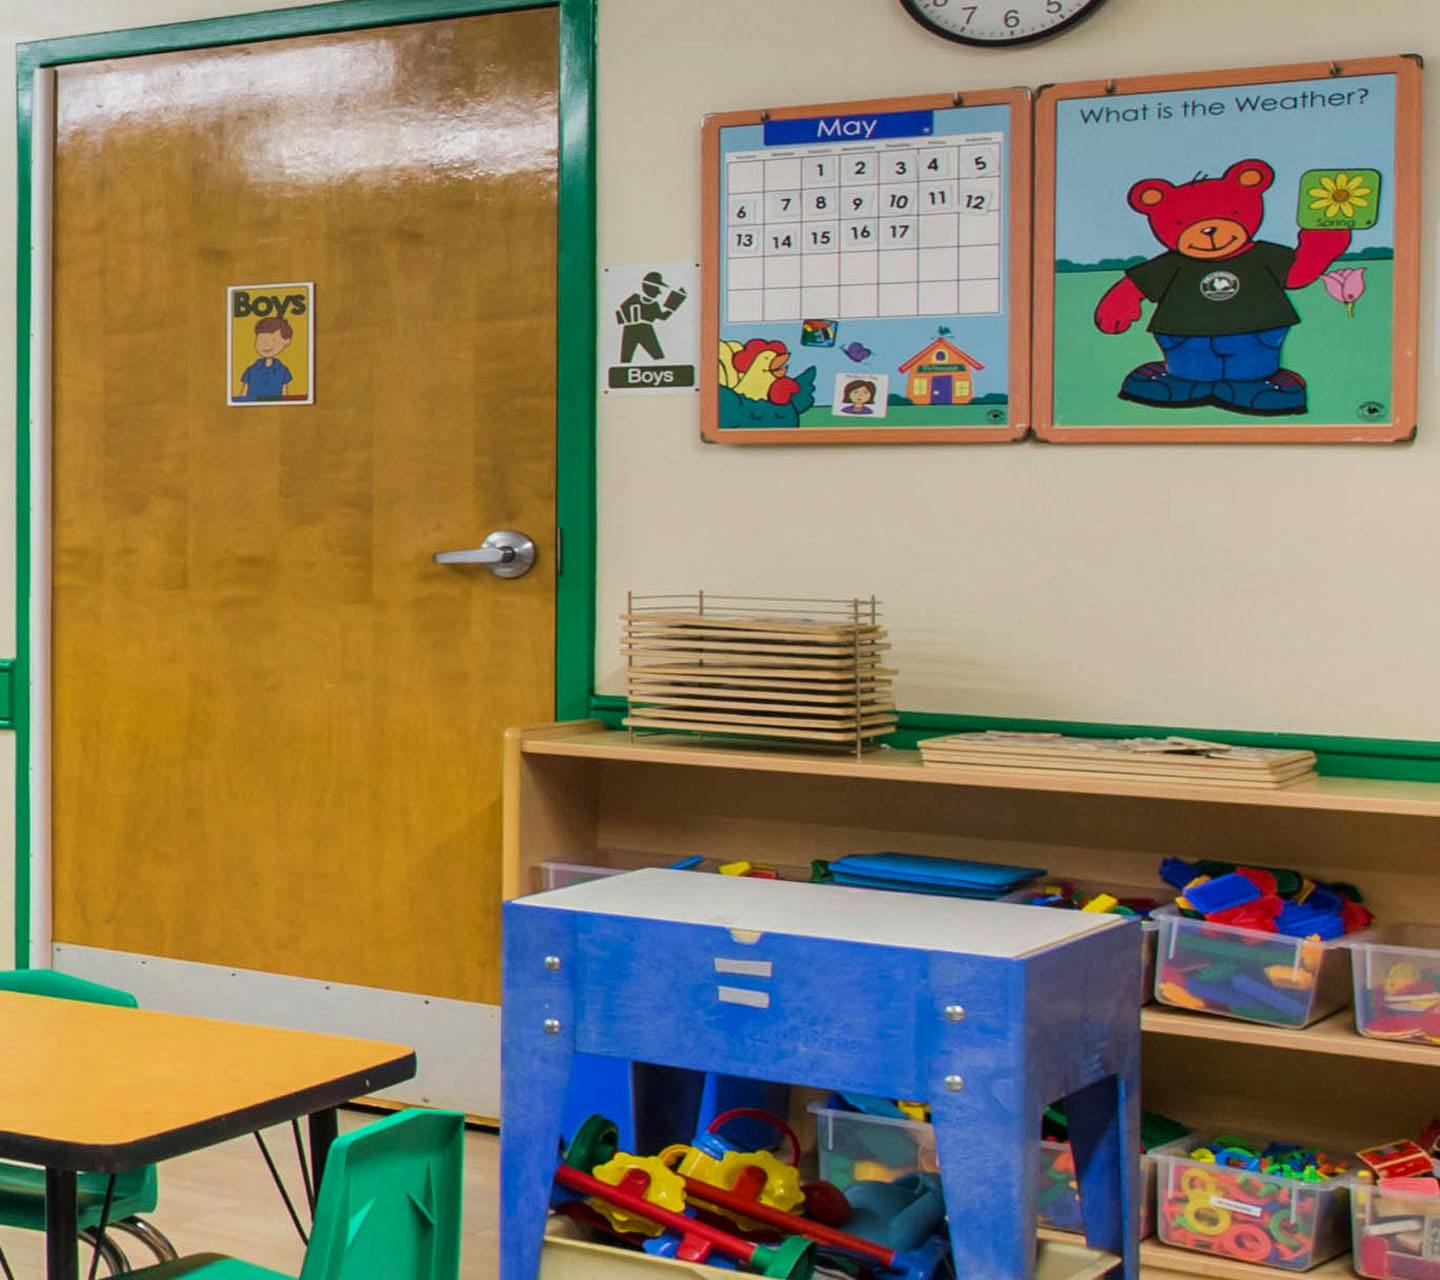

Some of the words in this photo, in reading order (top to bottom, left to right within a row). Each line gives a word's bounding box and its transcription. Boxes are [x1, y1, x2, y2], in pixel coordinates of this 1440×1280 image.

[962, 6, 978, 25] 7
[1003, 9, 1020, 29] 6
[1080, 104, 1148, 124] What
[1157, 105, 1173, 120] is
[1182, 100, 1225, 117] the
[1235, 87, 1369, 112] Weather?
[816, 118, 878, 140] May
[817, 163, 824, 177] 1
[854, 161, 866, 175] 2
[895, 161, 907, 175] 3
[927, 158, 939, 171] 4
[974, 156, 987, 171] 5
[736, 206, 747, 219] 6
[781, 198, 792, 211] 7
[815, 196, 827, 210] 8
[852, 197, 863, 211] 9
[890, 194, 909, 209] 10
[929, 190, 946, 205] 11
[966, 194, 985, 210] 12
[1317, 217, 1356, 229] Spring
[736, 233, 753, 247] 13
[773, 235, 792, 249] 14
[811, 231, 831, 245] 15
[851, 225, 871, 240] 16
[890, 224, 910, 238] 17
[233, 291, 307, 320] Boys
[626, 368, 675, 386] Boys
